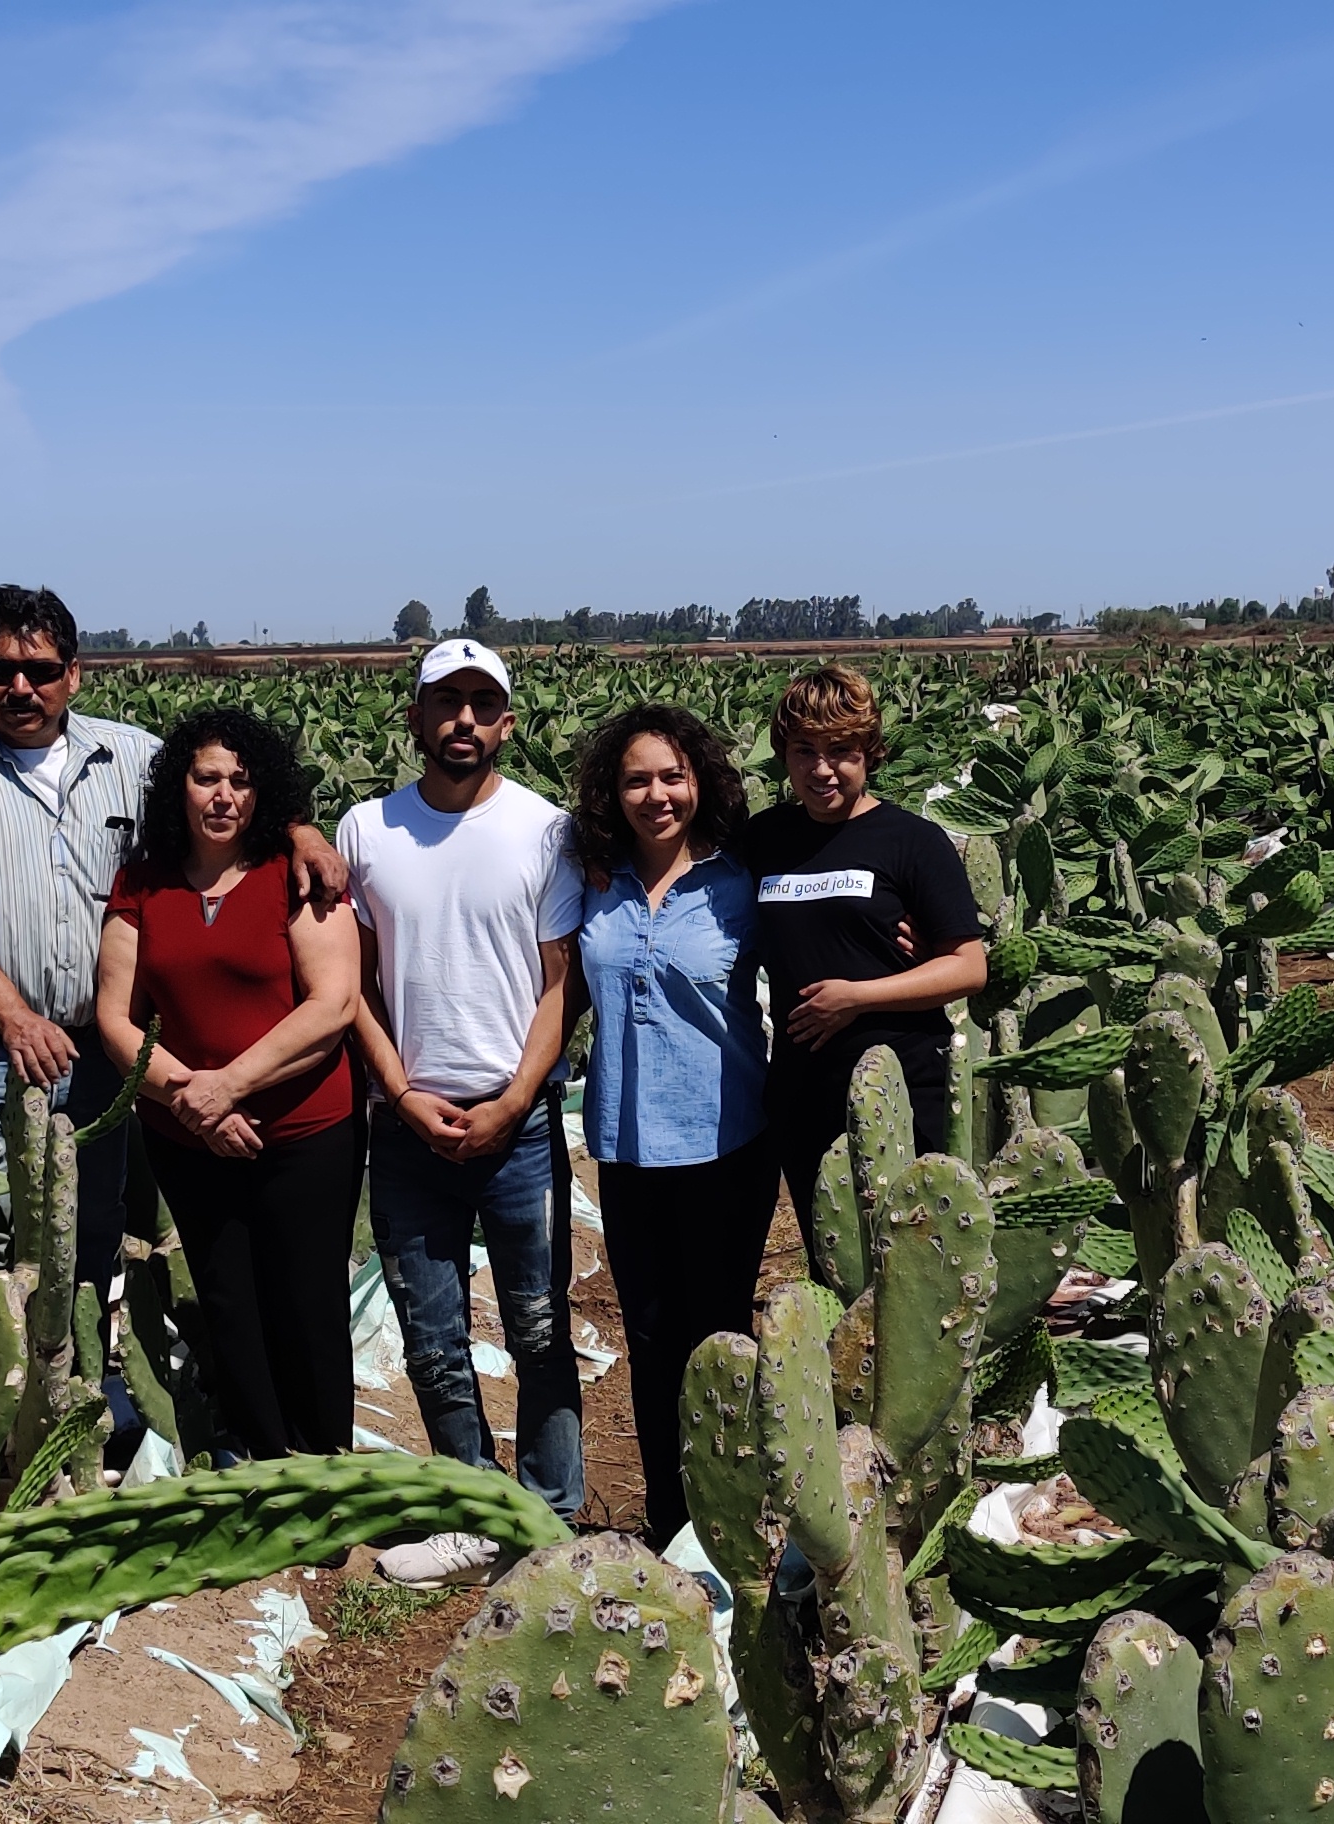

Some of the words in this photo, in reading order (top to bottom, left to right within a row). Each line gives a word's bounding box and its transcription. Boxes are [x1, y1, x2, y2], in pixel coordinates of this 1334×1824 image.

[761, 880, 791, 896] Fund
[794, 878, 829, 897] good
[831, 875, 867, 893] jobs.
